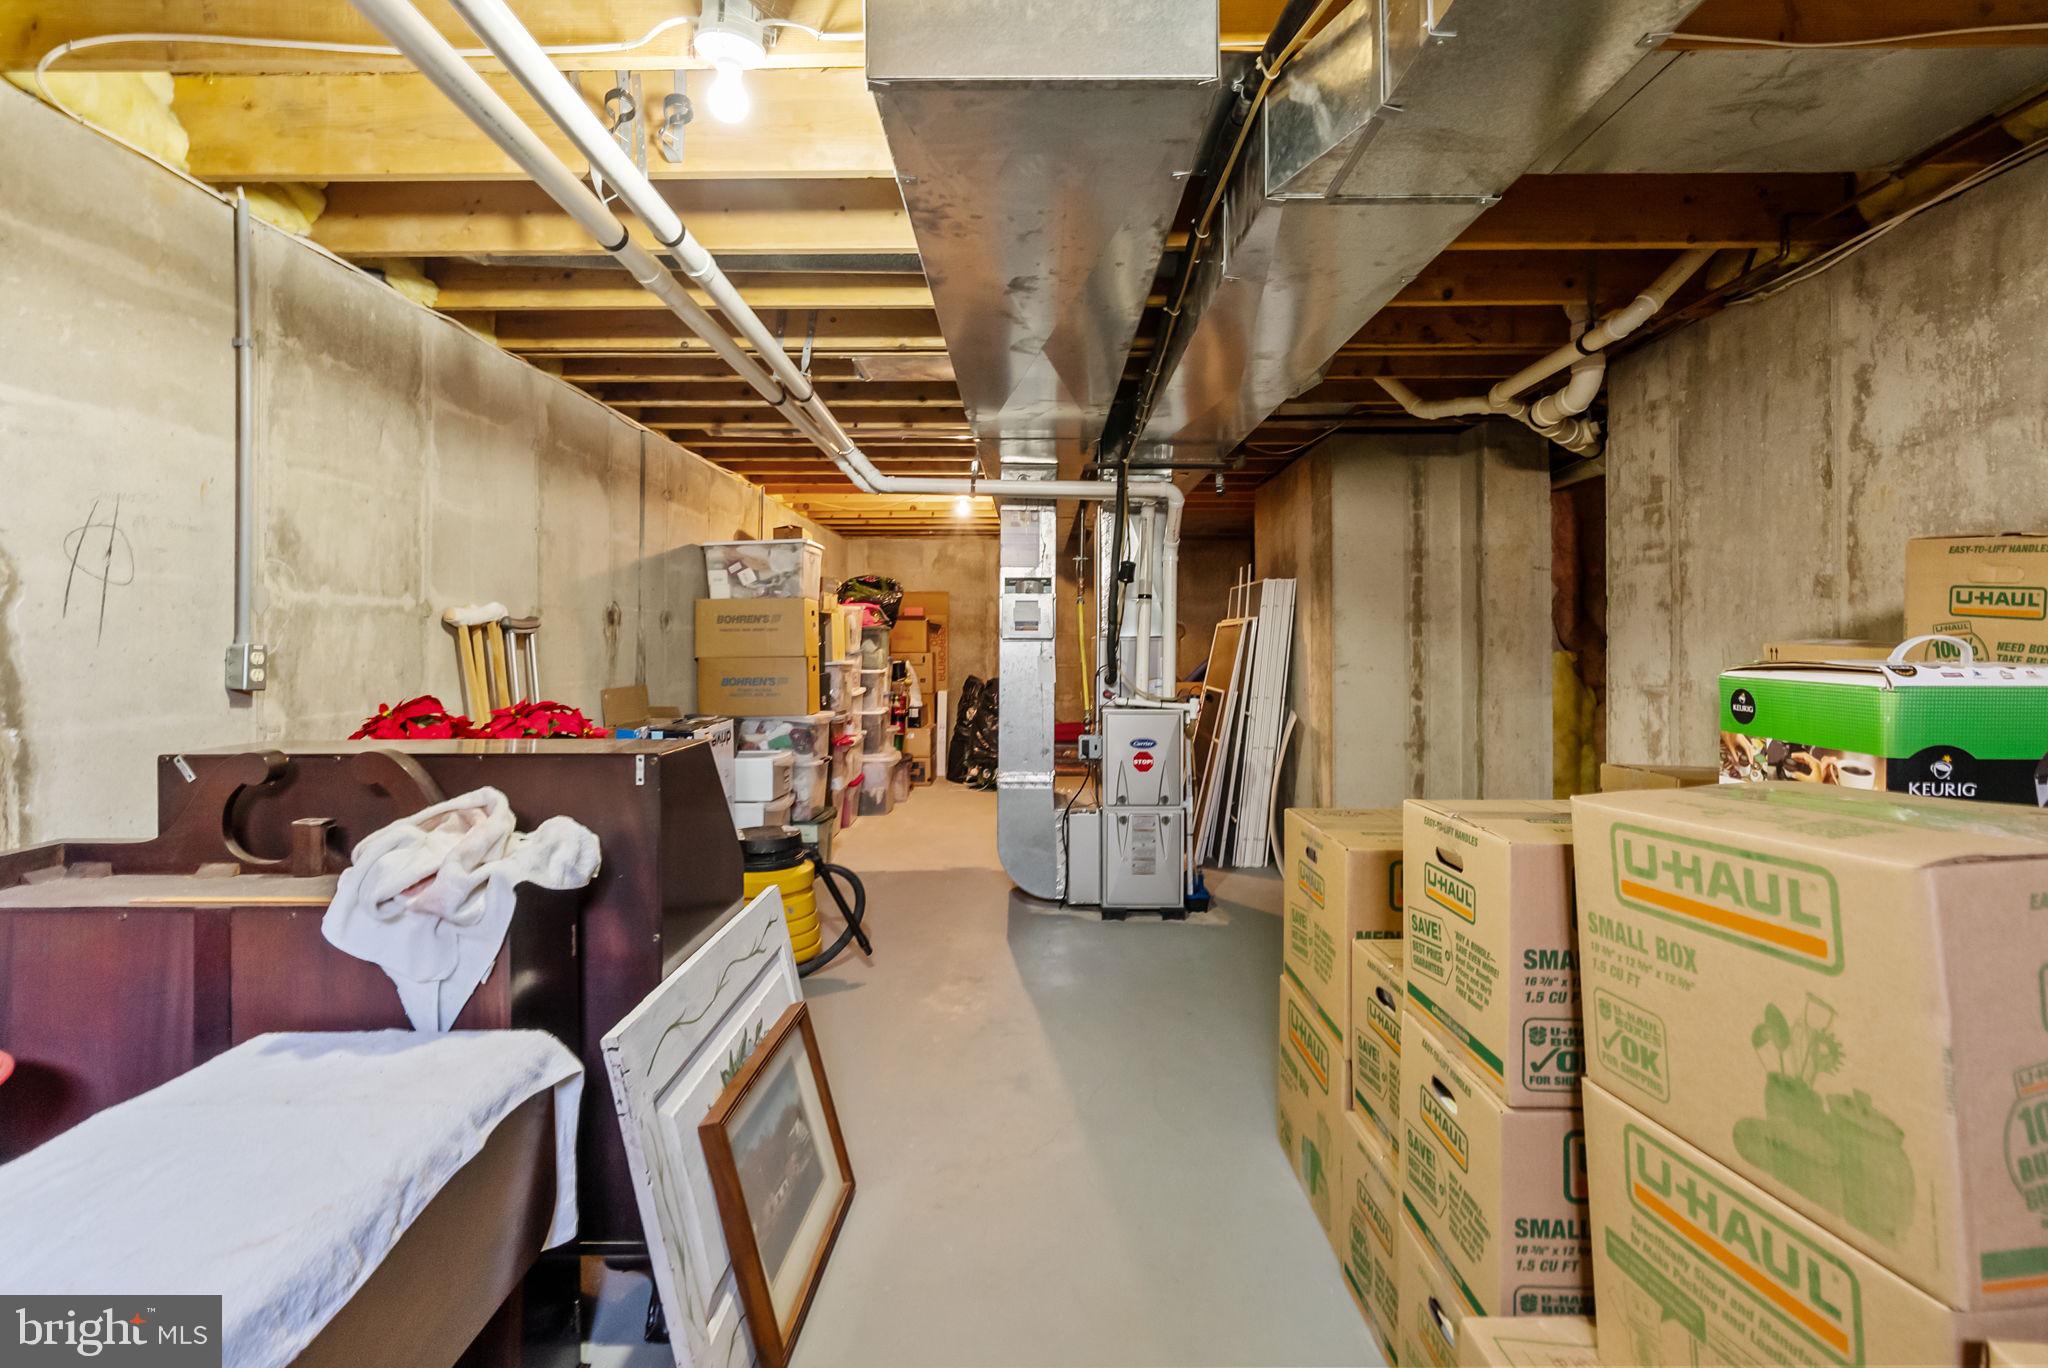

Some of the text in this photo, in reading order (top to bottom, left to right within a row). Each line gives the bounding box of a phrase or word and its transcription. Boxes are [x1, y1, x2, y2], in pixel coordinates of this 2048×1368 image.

[1948, 545, 2008, 554] EASY-TO-LIFT
[1955, 590, 2040, 608] U-HAUL
[716, 614, 770, 624] BOHREN'S
[1935, 623, 1969, 633] U-HAUL
[1996, 642, 2025, 653] NEED
[720, 676, 776, 687] BOHREN'S
[1732, 704, 1754, 713] KEURIG
[1908, 782, 1978, 797] KEURIG
[1423, 816, 1478, 847] EASY-TO-LIFT HANDLES
[1427, 868, 1473, 908] U-HAUL
[1622, 837, 1822, 929] U-HAUL
[1411, 913, 1442, 942] SAVE!
[1412, 940, 1426, 957] BEST
[1426, 946, 1443, 964] PRICE
[1587, 911, 1698, 975] SMALL BOX
[1524, 976, 1537, 987] 16
[1592, 957, 1641, 989] 1.5 CU FT
[1525, 991, 1545, 1004] 1.5
[1548, 991, 1568, 1004] CU
[1290, 1006, 1327, 1075] U-HAUL
[1357, 1035, 1380, 1065] SAVE!
[1619, 1034, 1662, 1079] OK
[1529, 1075, 1551, 1086] FOR
[1422, 1094, 1466, 1157] U-HAUL
[1407, 1128, 1436, 1172] SAVE!
[1358, 1184, 1391, 1242] U-HAUL
[1635, 1141, 1843, 1322] U-HAUL
[1552, 1247, 1559, 1255] x
[1516, 1259, 1580, 1273] 1.5 CU FT
[1642, 1239, 1670, 1272] Make
[1671, 1267, 1719, 1315] Packing
[1721, 1303, 1746, 1335] and
[1694, 1265, 1727, 1299] Sized
[1729, 1298, 1754, 1323] and
